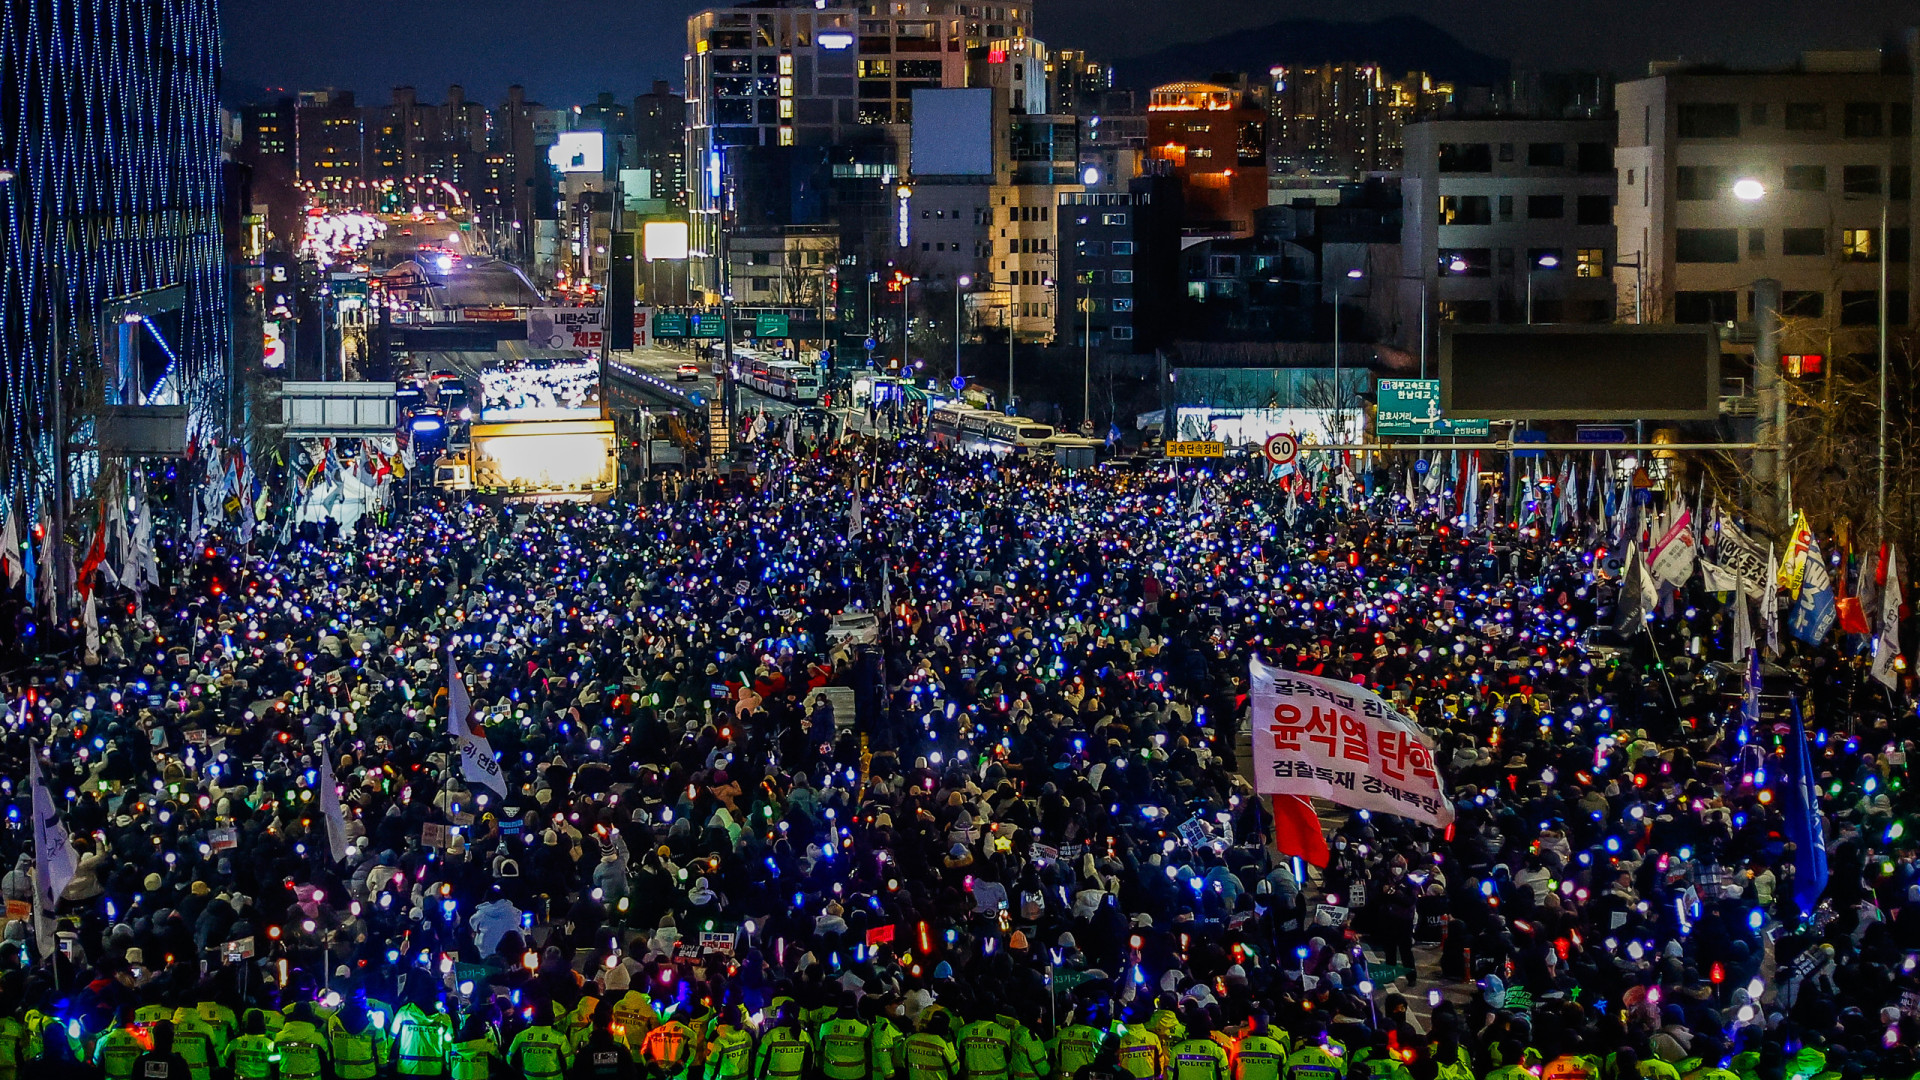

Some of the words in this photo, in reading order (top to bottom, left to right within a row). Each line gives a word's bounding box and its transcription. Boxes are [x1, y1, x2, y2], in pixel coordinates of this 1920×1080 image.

[888, 282, 902, 292] SK
[555, 310, 600, 325] 내란수괴
[573, 331, 602, 348] 체포
[1391, 382, 1432, 390] 경부고속도로
[1398, 390, 1432, 399] 한남대교
[1378, 412, 1412, 420] 금호사거리
[1169, 443, 1220, 455] 과속단속장비
[1272, 442, 1290, 455] 60
[1273, 678, 1355, 712] 굴욕외교
[1270, 704, 1369, 764] 윤석열
[1377, 731, 1439, 790] 탄핵
[477, 754, 499, 776] 연합
[1272, 760, 1355, 790] 검찰독재
[1362, 774, 1441, 815] 경제폭망
